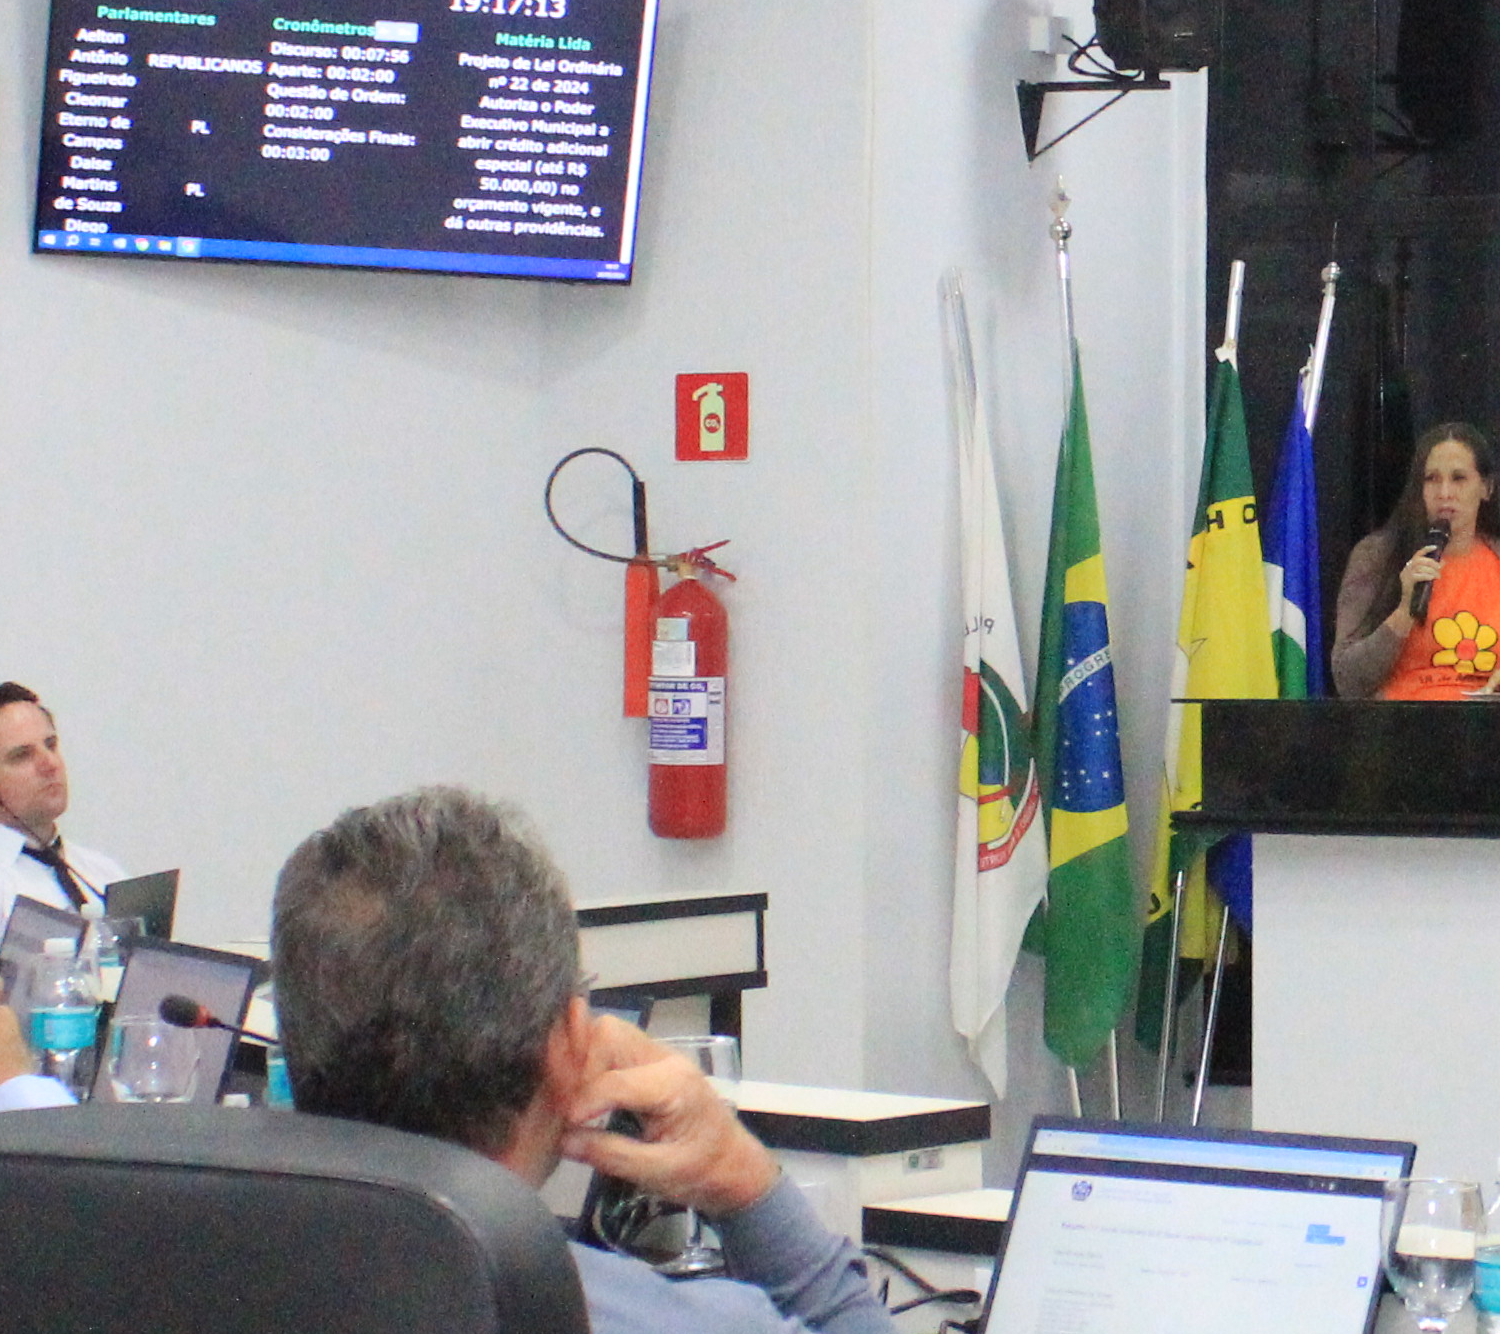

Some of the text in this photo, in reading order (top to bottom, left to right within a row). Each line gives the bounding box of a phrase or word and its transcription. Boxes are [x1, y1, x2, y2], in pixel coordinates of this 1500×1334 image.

[96, 5, 217, 26] Parlamentares
[272, 17, 375, 37] Cronômetros
[495, 32, 592, 51] Matéria Lida
[70, 49, 130, 66] Antônio
[269, 42, 412, 64] Discurso: 00:07:56
[147, 53, 263, 74] REPUBLICANOS
[267, 62, 397, 83] Aparte: 00:02:00
[458, 53, 623, 77] Projeto de Lei Ordinária
[59, 69, 138, 87] Figueiredo
[510, 77, 529, 91] 22
[533, 79, 551, 93] de
[554, 80, 590, 95] 2024
[64, 92, 129, 108] Cleomar
[266, 82, 407, 105] Questão de Ordem:
[264, 103, 336, 120] 00:02:00
[479, 96, 596, 115] Autoriza o Poder
[58, 112, 132, 130] Eterno de
[189, 120, 212, 135] PL
[460, 115, 610, 137] Executivo Municipal a
[62, 134, 125, 151] Campos
[262, 124, 417, 146] Considerações Finais:
[261, 144, 332, 161] 00:03:00
[457, 135, 608, 157] abrir crédito adicional
[475, 157, 588, 177] especial (até R$
[61, 176, 119, 193] Martins
[184, 182, 206, 197] PL
[479, 177, 580, 197] 50.000,00) no
[53, 197, 124, 213] de Souza
[453, 197, 602, 219] orçamento vigente, e
[444, 215, 604, 239] dá outras providências.
